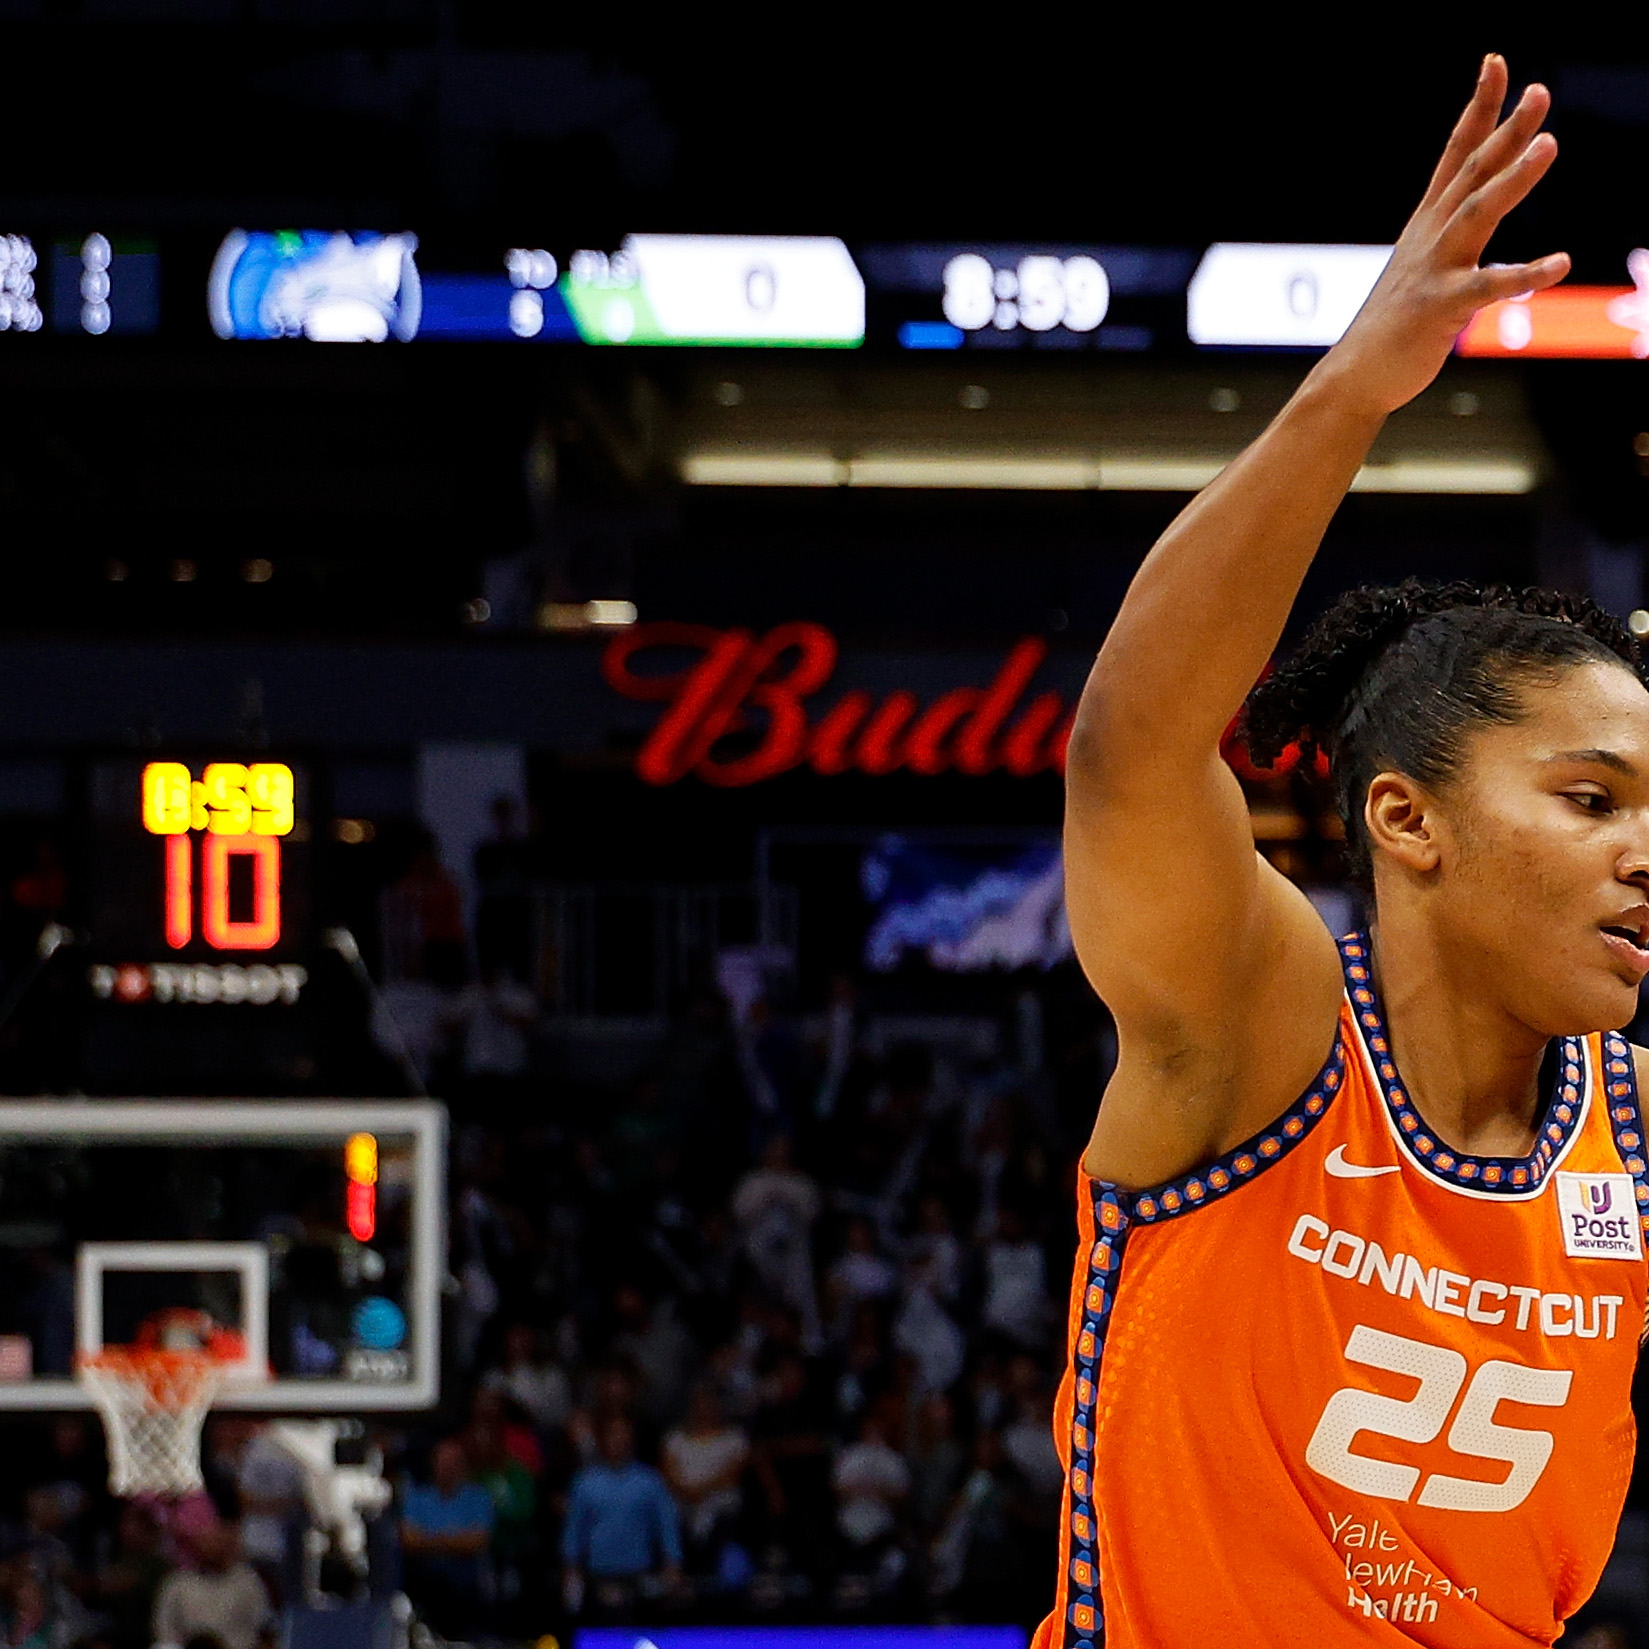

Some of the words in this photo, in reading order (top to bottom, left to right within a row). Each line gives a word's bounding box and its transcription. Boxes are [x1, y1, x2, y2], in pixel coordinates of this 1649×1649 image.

[165, 833, 281, 950] 10
[1288, 1213, 1624, 1339] CONNECTCUT
[1571, 1213, 1630, 1239] Post
[1573, 1238, 1630, 1251] UNIVERSITY
[1305, 1323, 1574, 1513] 25
